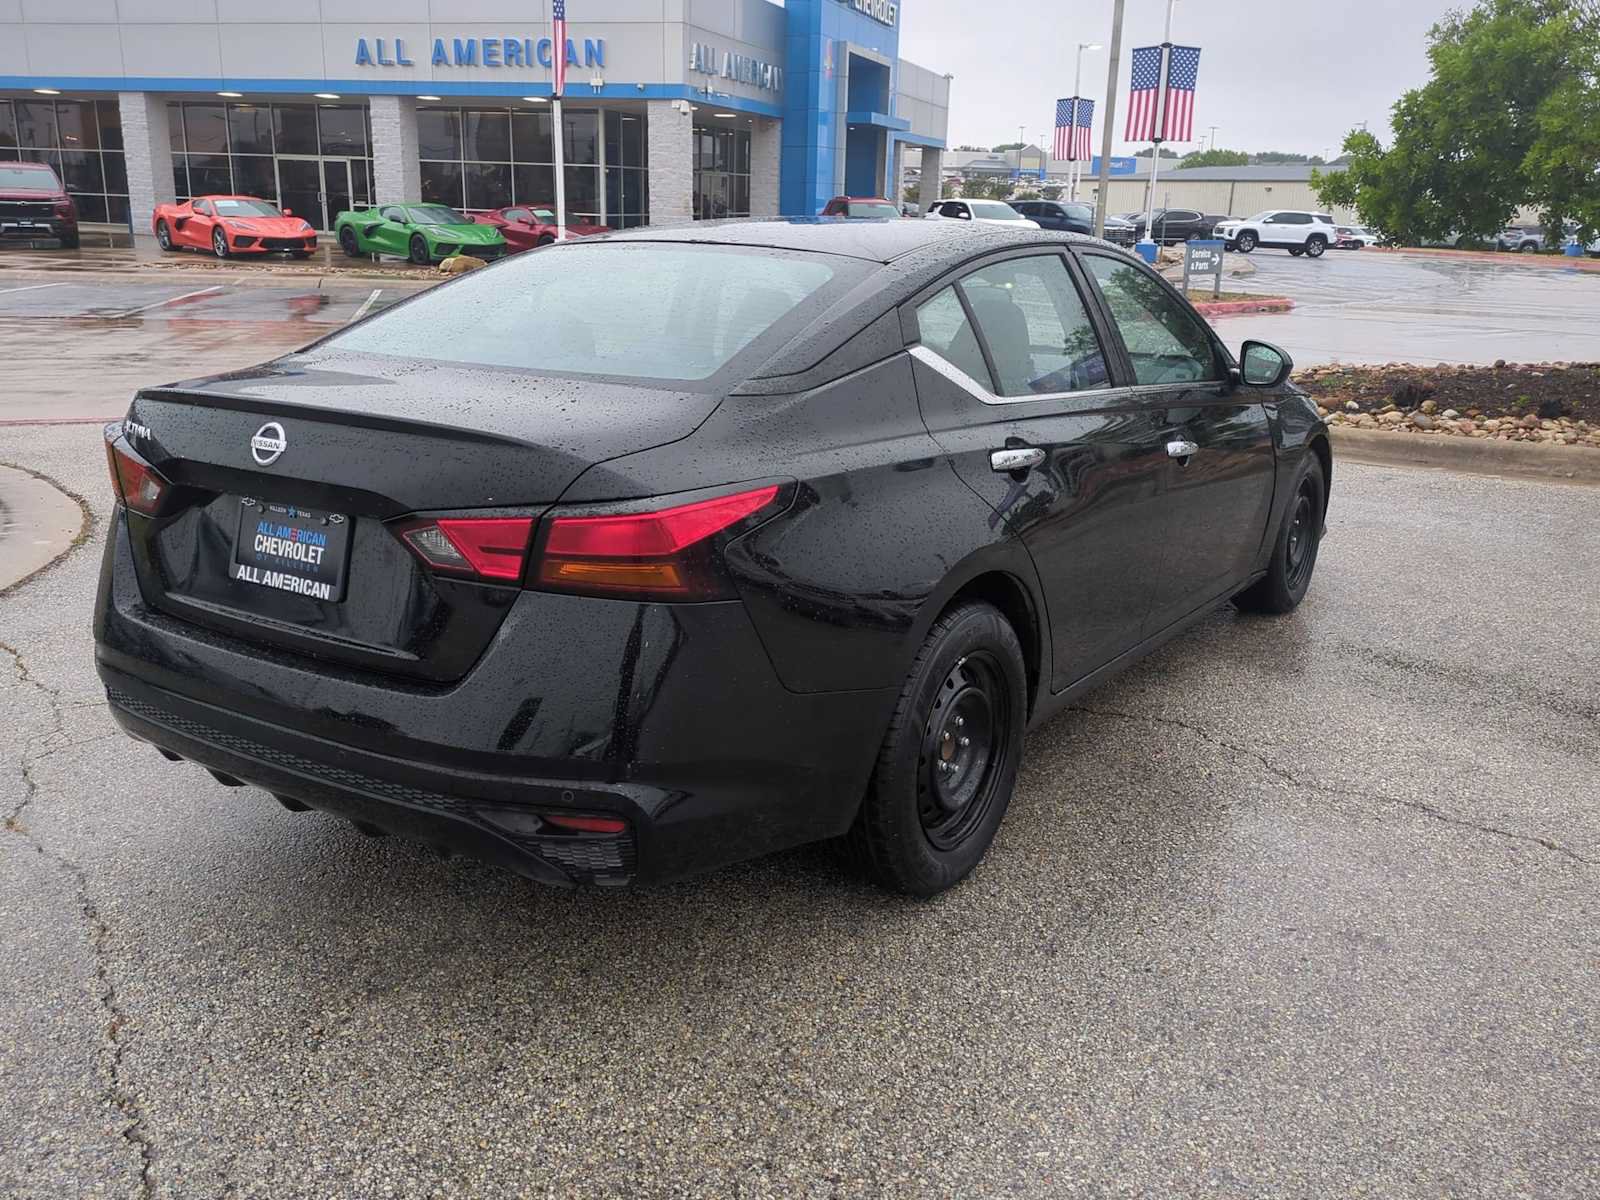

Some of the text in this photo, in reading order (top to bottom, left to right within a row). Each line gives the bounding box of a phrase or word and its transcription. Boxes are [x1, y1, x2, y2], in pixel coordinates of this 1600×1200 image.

[355, 38, 606, 68] ALL AMERICAN
[688, 42, 718, 75] ALL
[1191, 249, 1211, 259] Service
[1196, 262, 1209, 270] Parts
[252, 438, 281, 450] NISSAN
[256, 521, 327, 547] ALL AMERICAN
[254, 534, 325, 565] CHEVROLET
[236, 564, 330, 600] ALL AMERICAN
